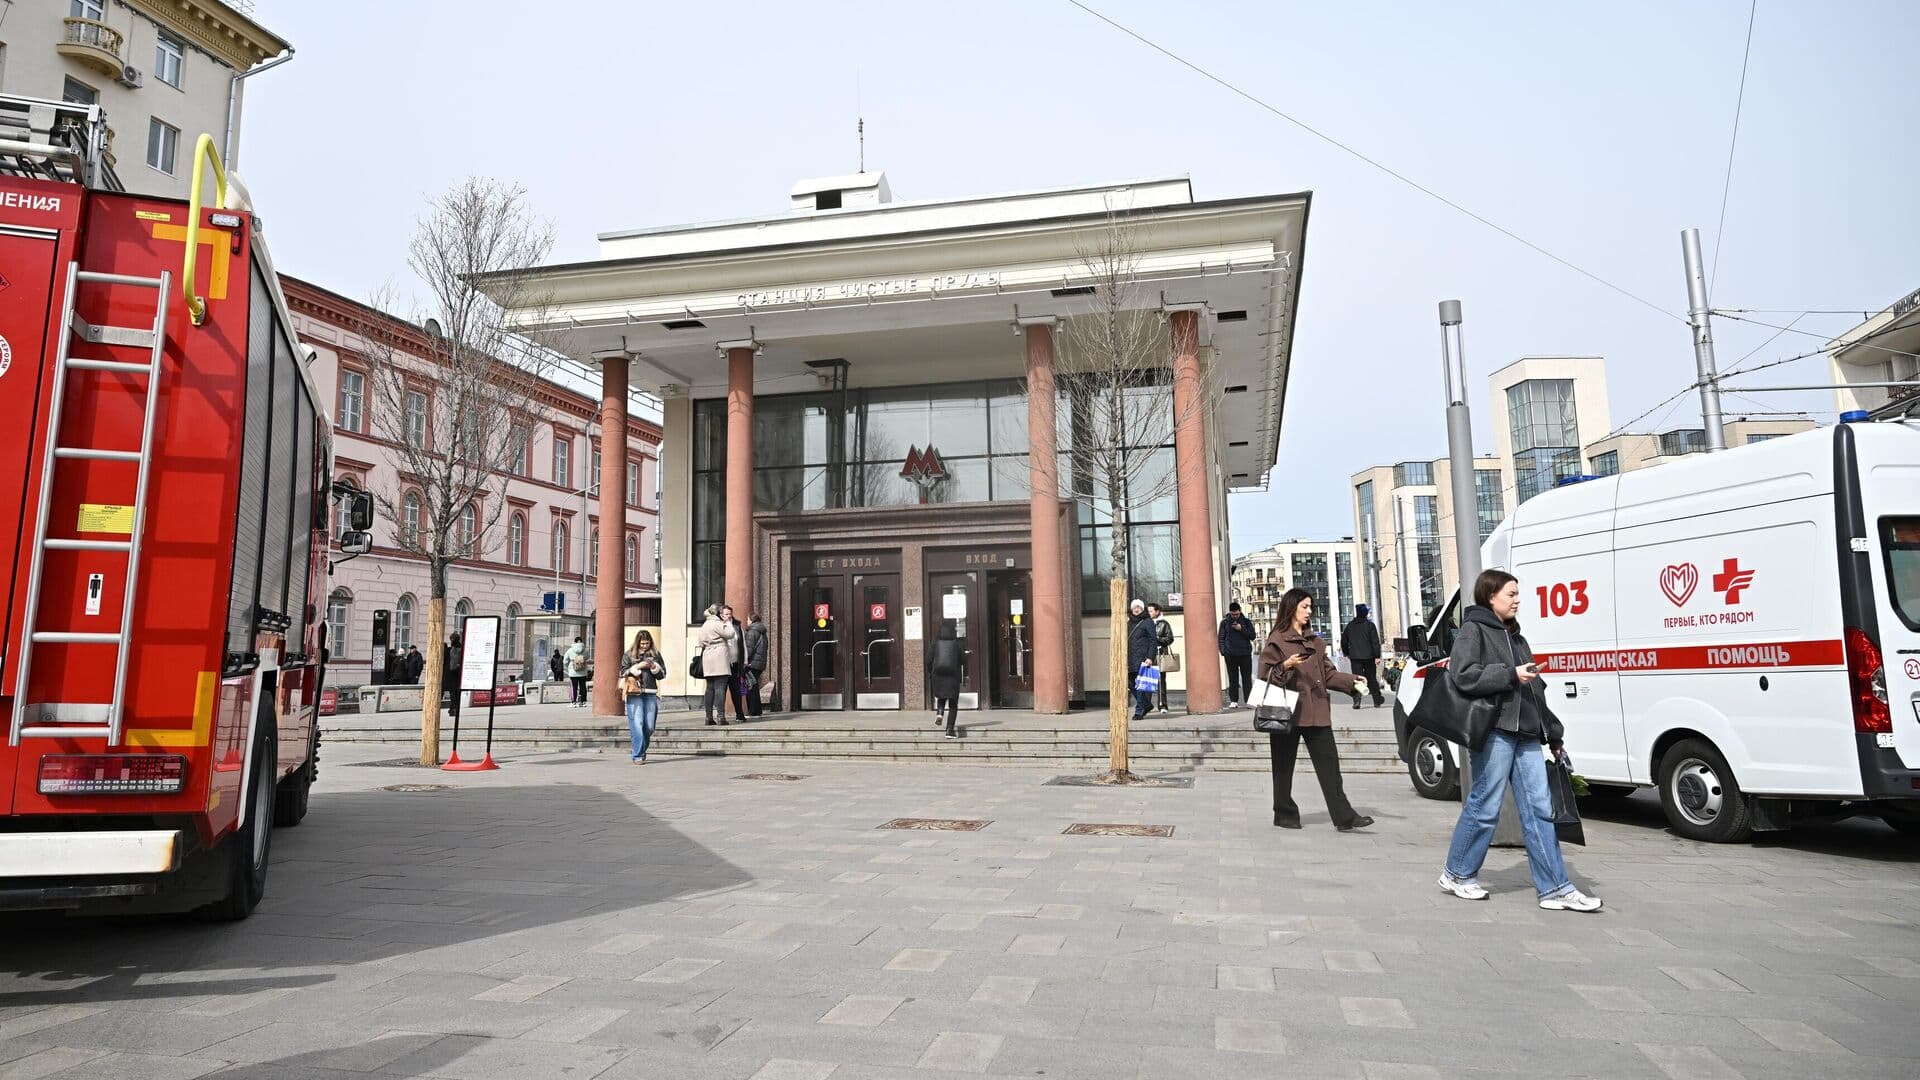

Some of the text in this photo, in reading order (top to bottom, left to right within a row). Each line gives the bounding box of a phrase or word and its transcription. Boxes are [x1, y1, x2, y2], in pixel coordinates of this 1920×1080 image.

[737, 271, 1001, 307] СТАНЦИЯ ЧИСТЫЕ ПРУДЫ
[842, 556, 880, 568] ВХОДА
[966, 553, 998, 564] ВХОД
[1536, 579, 1589, 618] 103
[1664, 611, 1754, 628] ПЕРВЫЕ, КТО РЯДОМ
[1547, 645, 1790, 672] МЕДИЦИНСКАЯ ПОМОЩЬ
